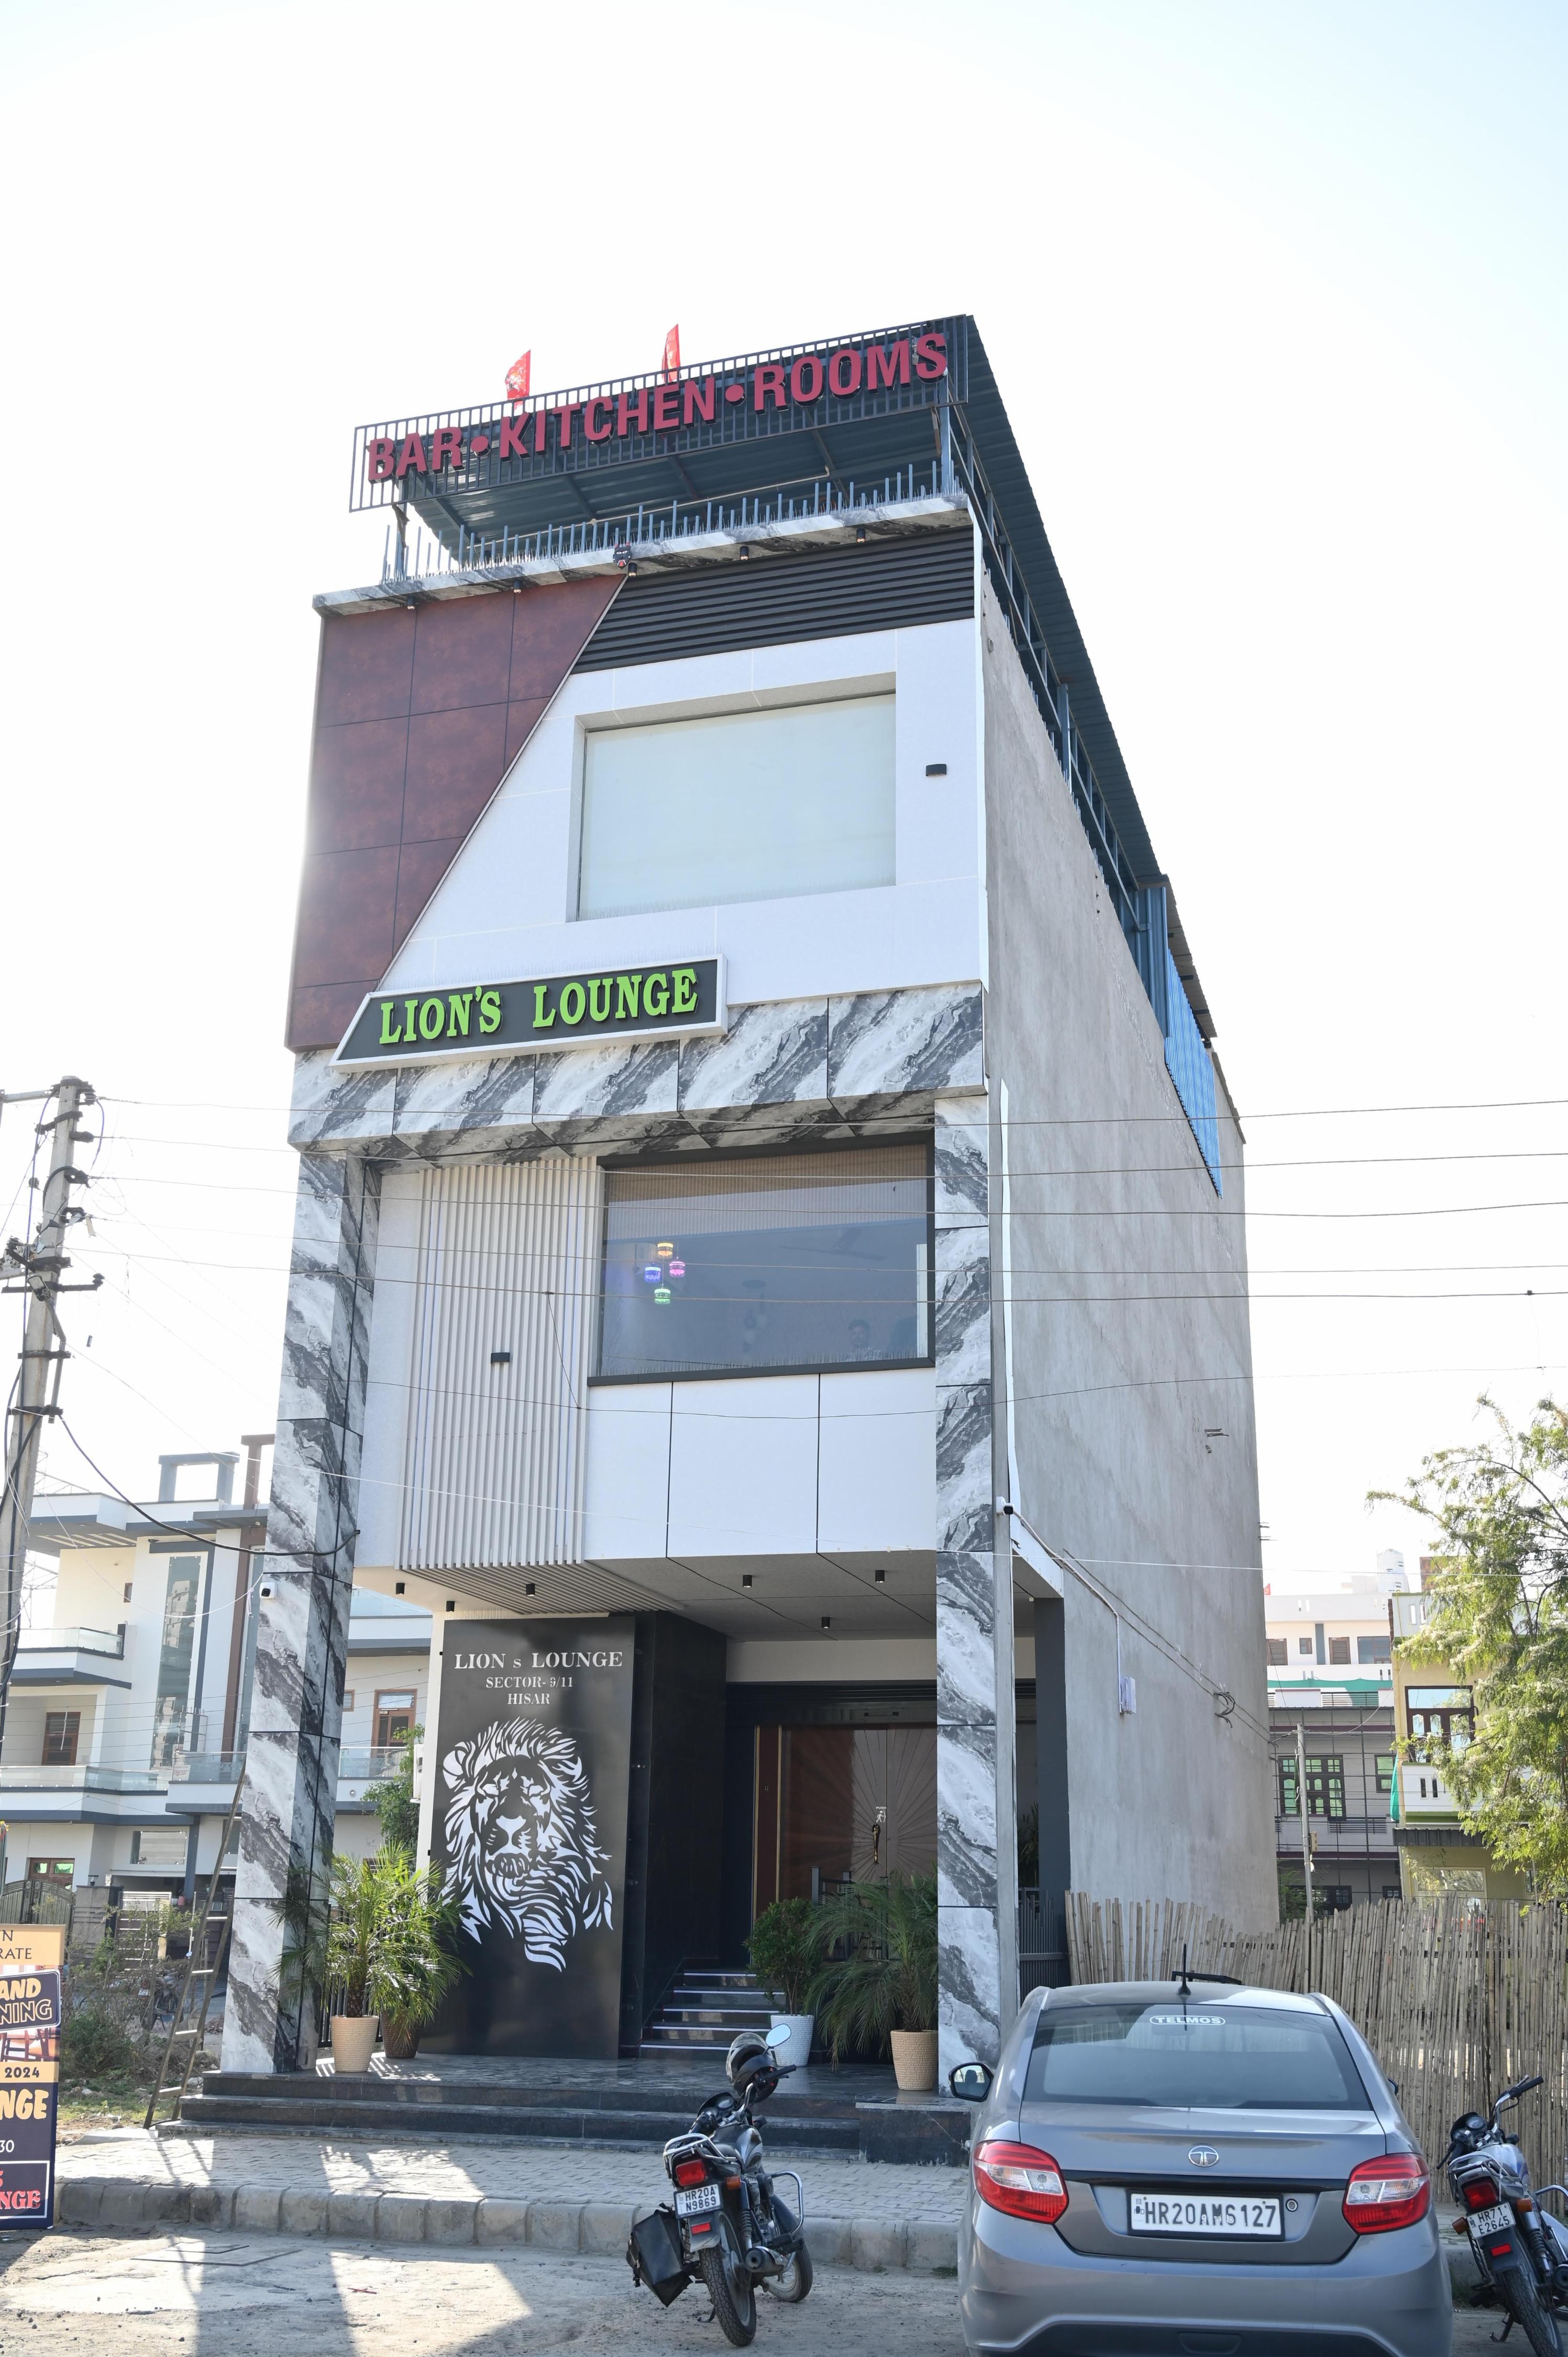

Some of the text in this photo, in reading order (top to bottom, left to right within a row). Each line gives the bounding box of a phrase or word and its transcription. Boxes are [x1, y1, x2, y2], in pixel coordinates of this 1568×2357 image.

[369, 333, 948, 483] BAR KITCHEN ROOMS
[379, 968, 699, 1044] LION'S LOUNGE
[455, 1653, 506, 1669] LION
[532, 1651, 623, 1668] LOUNGE
[485, 1677, 573, 1688] SECTOR- 9/11
[507, 1693, 550, 1704] HISAR
[4, 2067, 40, 2078] 2024
[685, 2186, 715, 2201] HR20A
[686, 2196, 716, 2211] N9869
[1477, 2207, 1503, 2223] HR71
[1478, 2216, 1510, 2234] E2645
